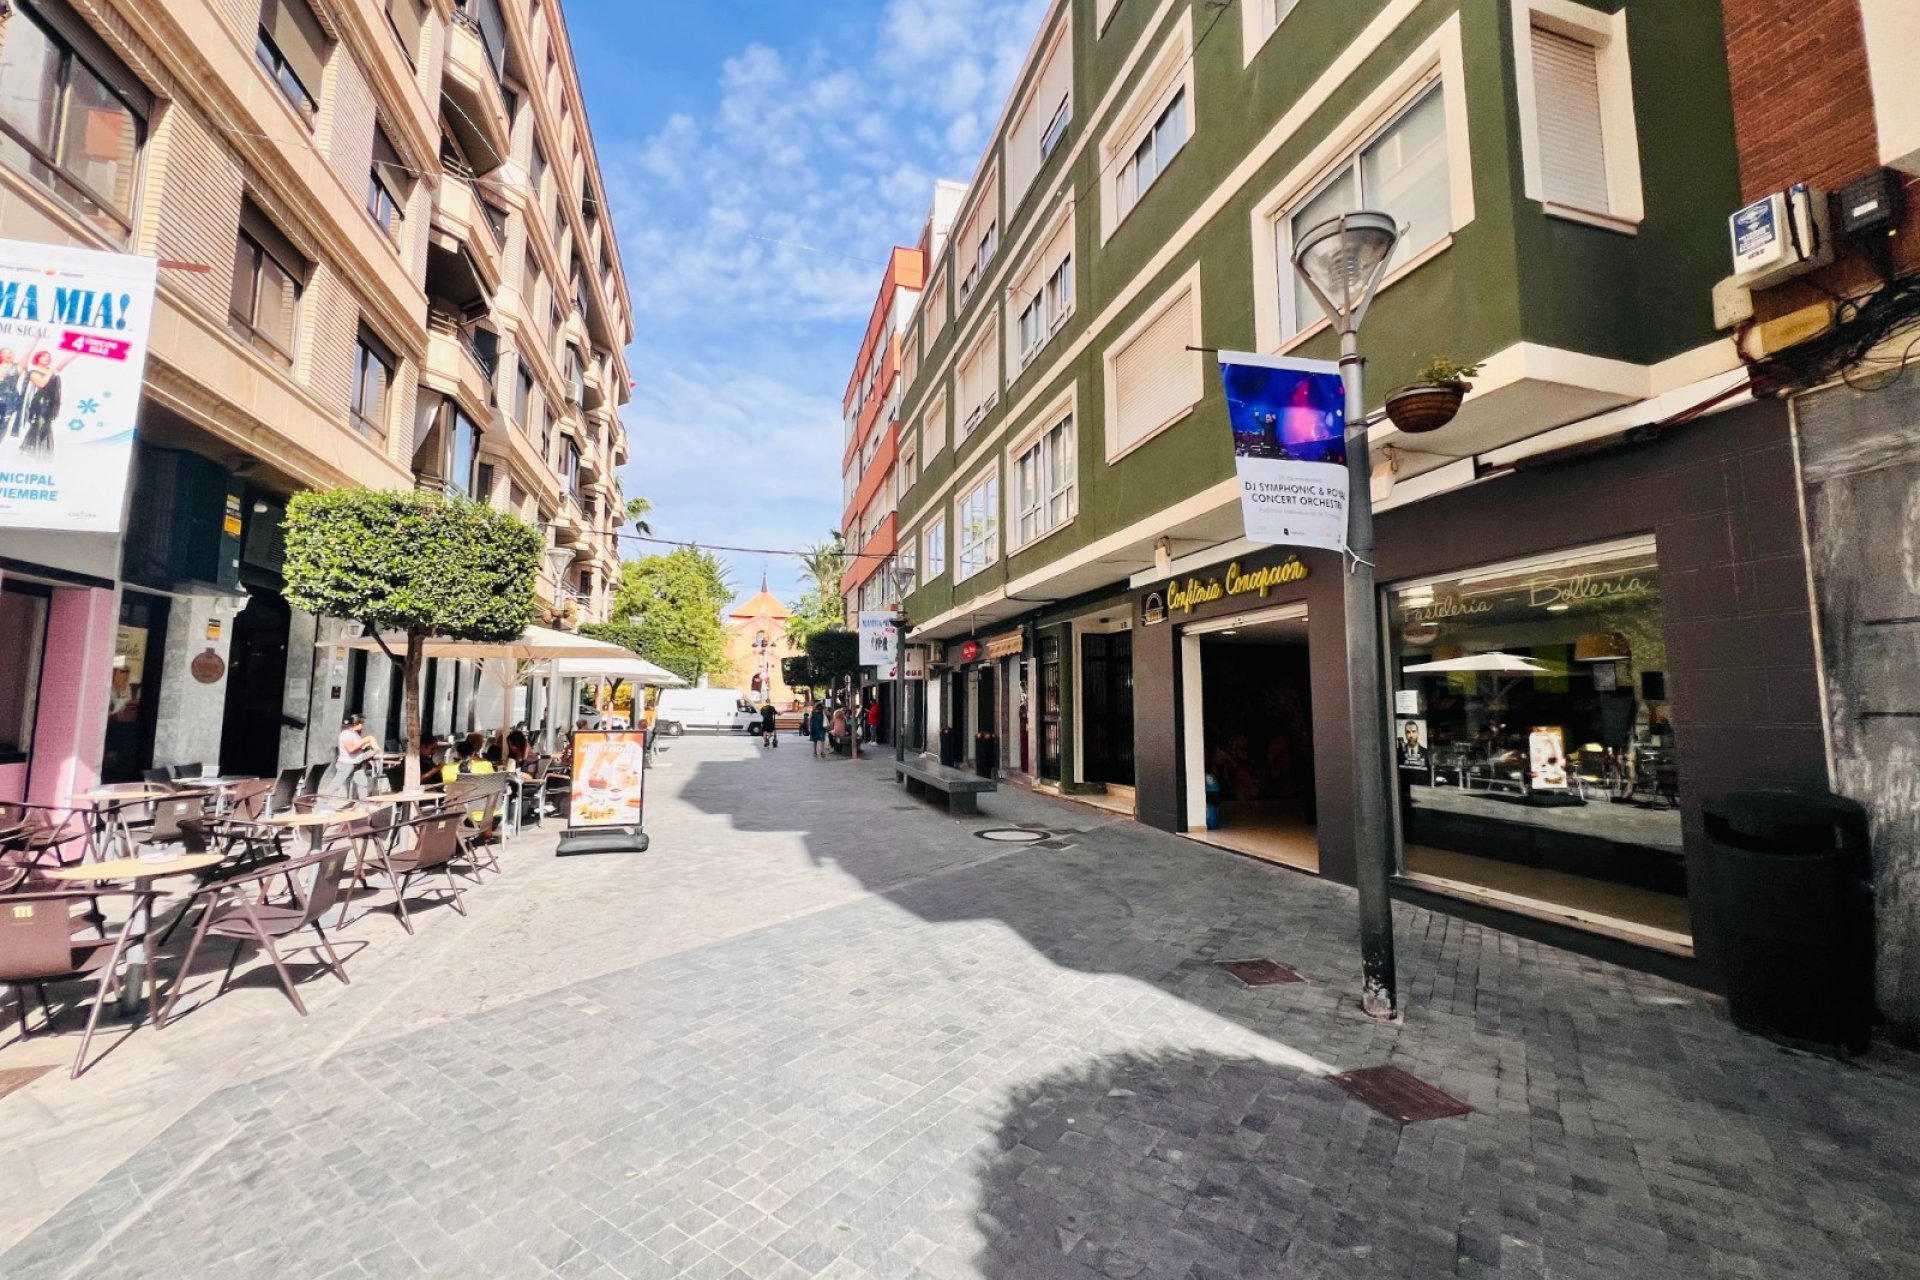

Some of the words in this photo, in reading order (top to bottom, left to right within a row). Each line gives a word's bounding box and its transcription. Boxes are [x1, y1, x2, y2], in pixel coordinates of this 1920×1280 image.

[48, 286, 131, 331] MIA!
[71, 336, 85, 350] 4
[1245, 481, 1256, 491] DJ
[1259, 482, 1316, 496] SYMPHONIC
[1318, 487, 1325, 496] &
[1251, 493, 1297, 505] CONCERT
[1526, 574, 1651, 608] Bollería
